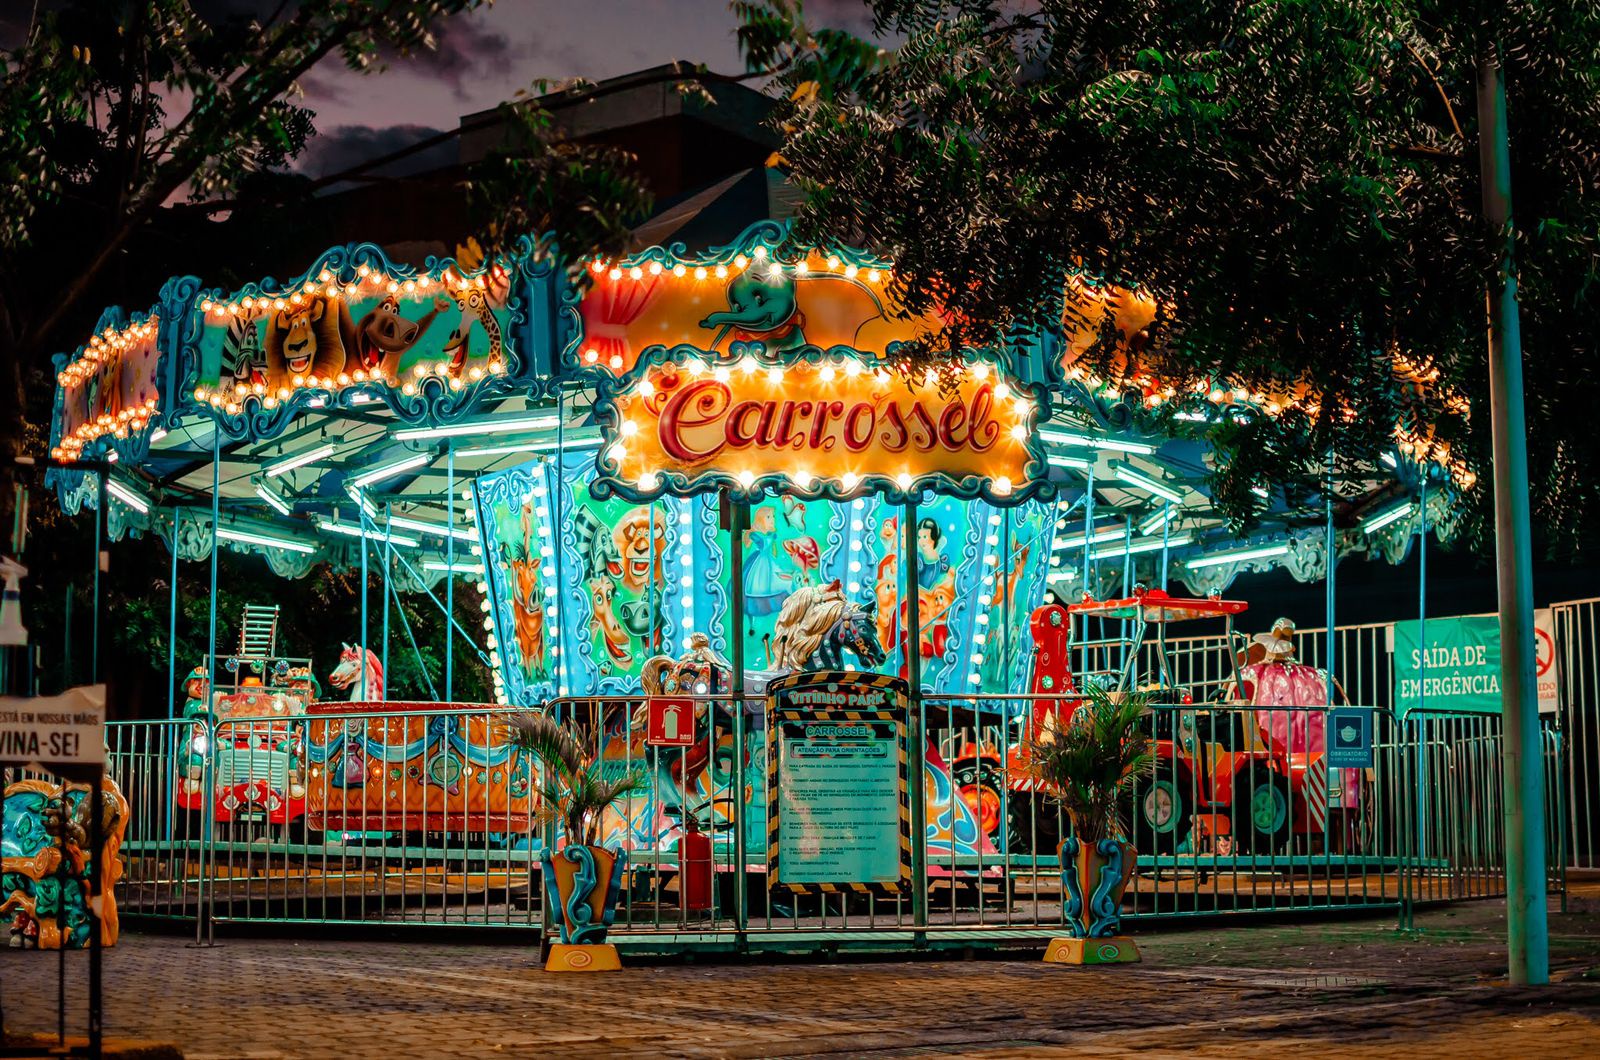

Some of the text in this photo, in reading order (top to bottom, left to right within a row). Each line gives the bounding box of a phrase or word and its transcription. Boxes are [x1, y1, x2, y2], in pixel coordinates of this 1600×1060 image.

[644, 373, 1000, 464] Carrossel
[1412, 641, 1486, 670] SAÍDA DE
[1401, 671, 1500, 698] EMERGÊNCIA
[848, 691, 885, 706] PARK
[21, 712, 34, 723] EM
[37, 712, 71, 725] NOSSAS
[74, 711, 98, 726] MÃOS
[806, 726, 871, 737] CARROSSEL
